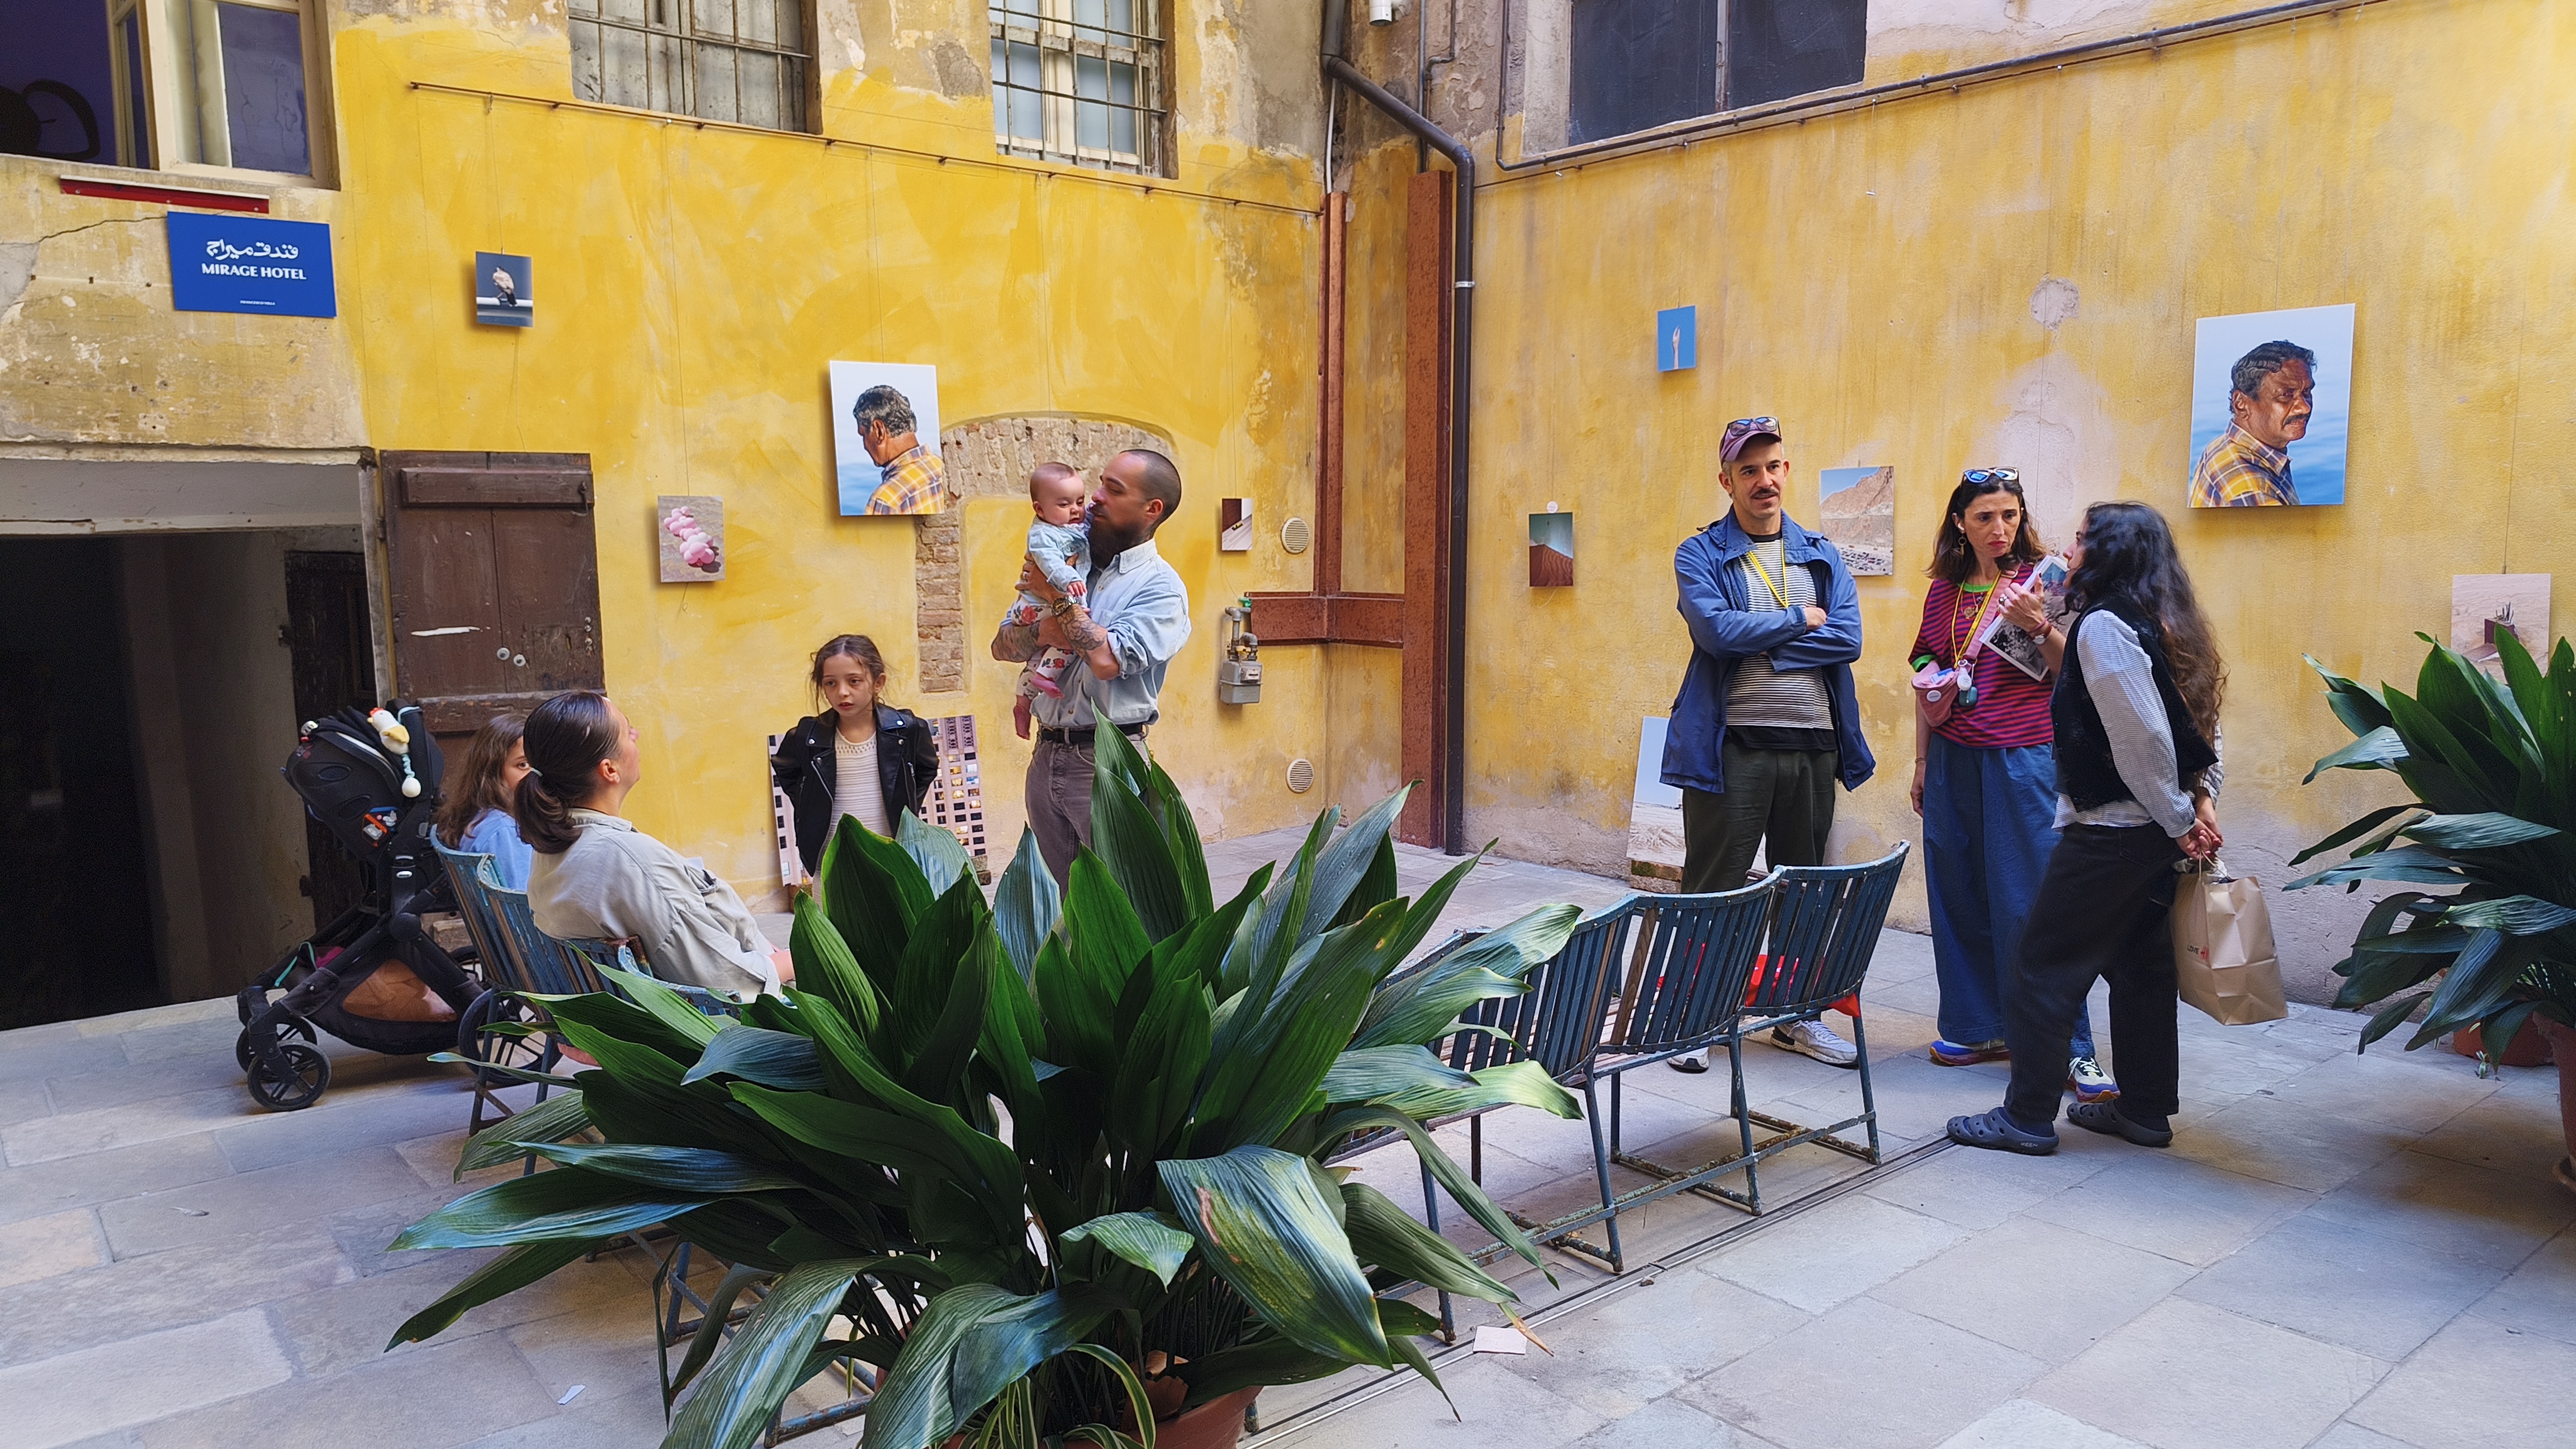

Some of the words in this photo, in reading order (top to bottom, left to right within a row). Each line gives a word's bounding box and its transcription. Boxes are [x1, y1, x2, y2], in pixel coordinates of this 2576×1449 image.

[207, 239, 253, 261] ميراج
[253, 242, 299, 259] فندق
[202, 263, 258, 277] MIRAGE
[261, 267, 307, 280] HOTEL
